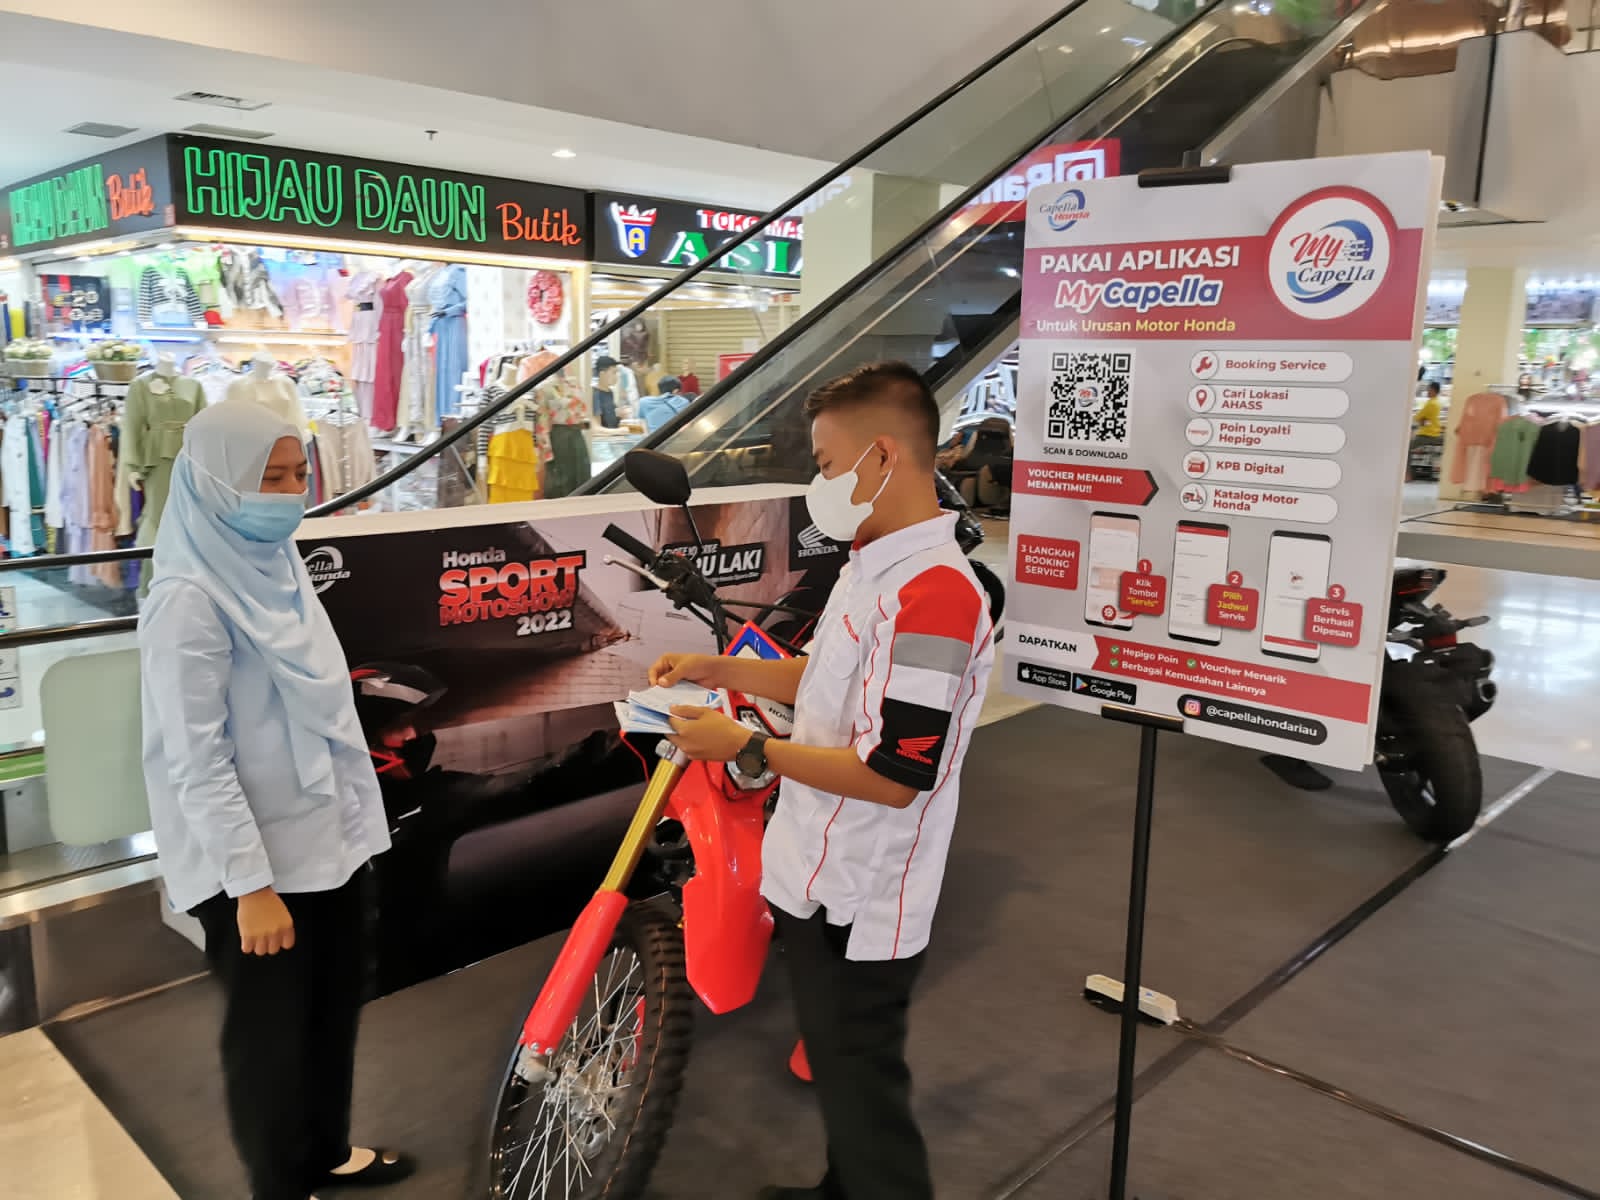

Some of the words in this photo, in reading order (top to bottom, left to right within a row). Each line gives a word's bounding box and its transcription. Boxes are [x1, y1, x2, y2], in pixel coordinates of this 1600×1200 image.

[184, 146, 342, 227] HIJAU
[355, 168, 487, 243] DAUN
[496, 201, 581, 246] Butik
[1039, 202, 1078, 215] Capella
[1055, 211, 1090, 221] Honda
[661, 231, 803, 276] ASI
[1289, 232, 1344, 269] My
[1039, 251, 1112, 274] PAKAI
[1119, 245, 1240, 272] APLIKASI
[1298, 265, 1376, 285] Capella
[1036, 318, 1078, 333] Untuk
[1081, 318, 1132, 333] Urusan
[1136, 318, 1179, 333] Motor
[1183, 318, 1236, 333] Honda
[1225, 359, 1276, 372] Booking
[1280, 360, 1327, 371] Service
[1222, 388, 1246, 399] Cari
[1249, 389, 1289, 400] Lokasi
[1221, 400, 1264, 411] AHASS
[1219, 422, 1246, 433] Poin
[1249, 424, 1292, 436] Loyalti
[1218, 433, 1261, 446] Hepigo
[1043, 447, 1067, 457] SCAN
[1067, 448, 1073, 457] &
[1075, 449, 1128, 460] DOWNLOAD
[1216, 460, 1241, 471] KPB
[1243, 462, 1285, 475] Digital
[1028, 468, 1074, 481] VOUCHER
[1076, 472, 1124, 485] MENARIK
[1027, 480, 1093, 494] MENANTIMU!!
[1213, 488, 1259, 503] Katalog
[1262, 493, 1299, 505] Motor
[1212, 500, 1251, 511] Honda
[797, 544, 840, 558] HONDA
[1020, 544, 1027, 553] 3
[1029, 545, 1075, 558] LANGKAH
[443, 548, 506, 569] Honda
[719, 549, 763, 575] LAKI
[1025, 555, 1070, 569] BOOKING
[306, 560, 334, 572] ella
[1024, 565, 1065, 578] SERVICE
[1142, 561, 1149, 572] 1
[439, 554, 585, 608] SPORT
[1230, 574, 1240, 584] 2
[1128, 587, 1159, 600] Tombol
[1332, 588, 1341, 598] 3
[440, 590, 575, 626] MOTOSHOW
[1216, 600, 1249, 612] Jadwal
[1319, 604, 1350, 617] Servis
[1218, 610, 1246, 622] Servis
[1312, 614, 1355, 628] Berhasil
[516, 610, 572, 637] 2022
[1312, 625, 1353, 639] Dipesan
[1018, 634, 1077, 653] DAPATKAN
[1122, 647, 1156, 662] Hepigo
[1157, 653, 1179, 665] Poin
[1200, 660, 1242, 677] Voucher
[1243, 669, 1288, 685] Menarik
[1031, 673, 1047, 684] App
[1047, 675, 1068, 687] Store
[1121, 660, 1163, 676] Berbagai
[1164, 668, 1224, 688] Kemudahan
[1226, 678, 1267, 697] Lainnya
[1089, 684, 1117, 698] Google
[1117, 689, 1133, 703] Play
[1206, 705, 1318, 737] @capellahondariau
